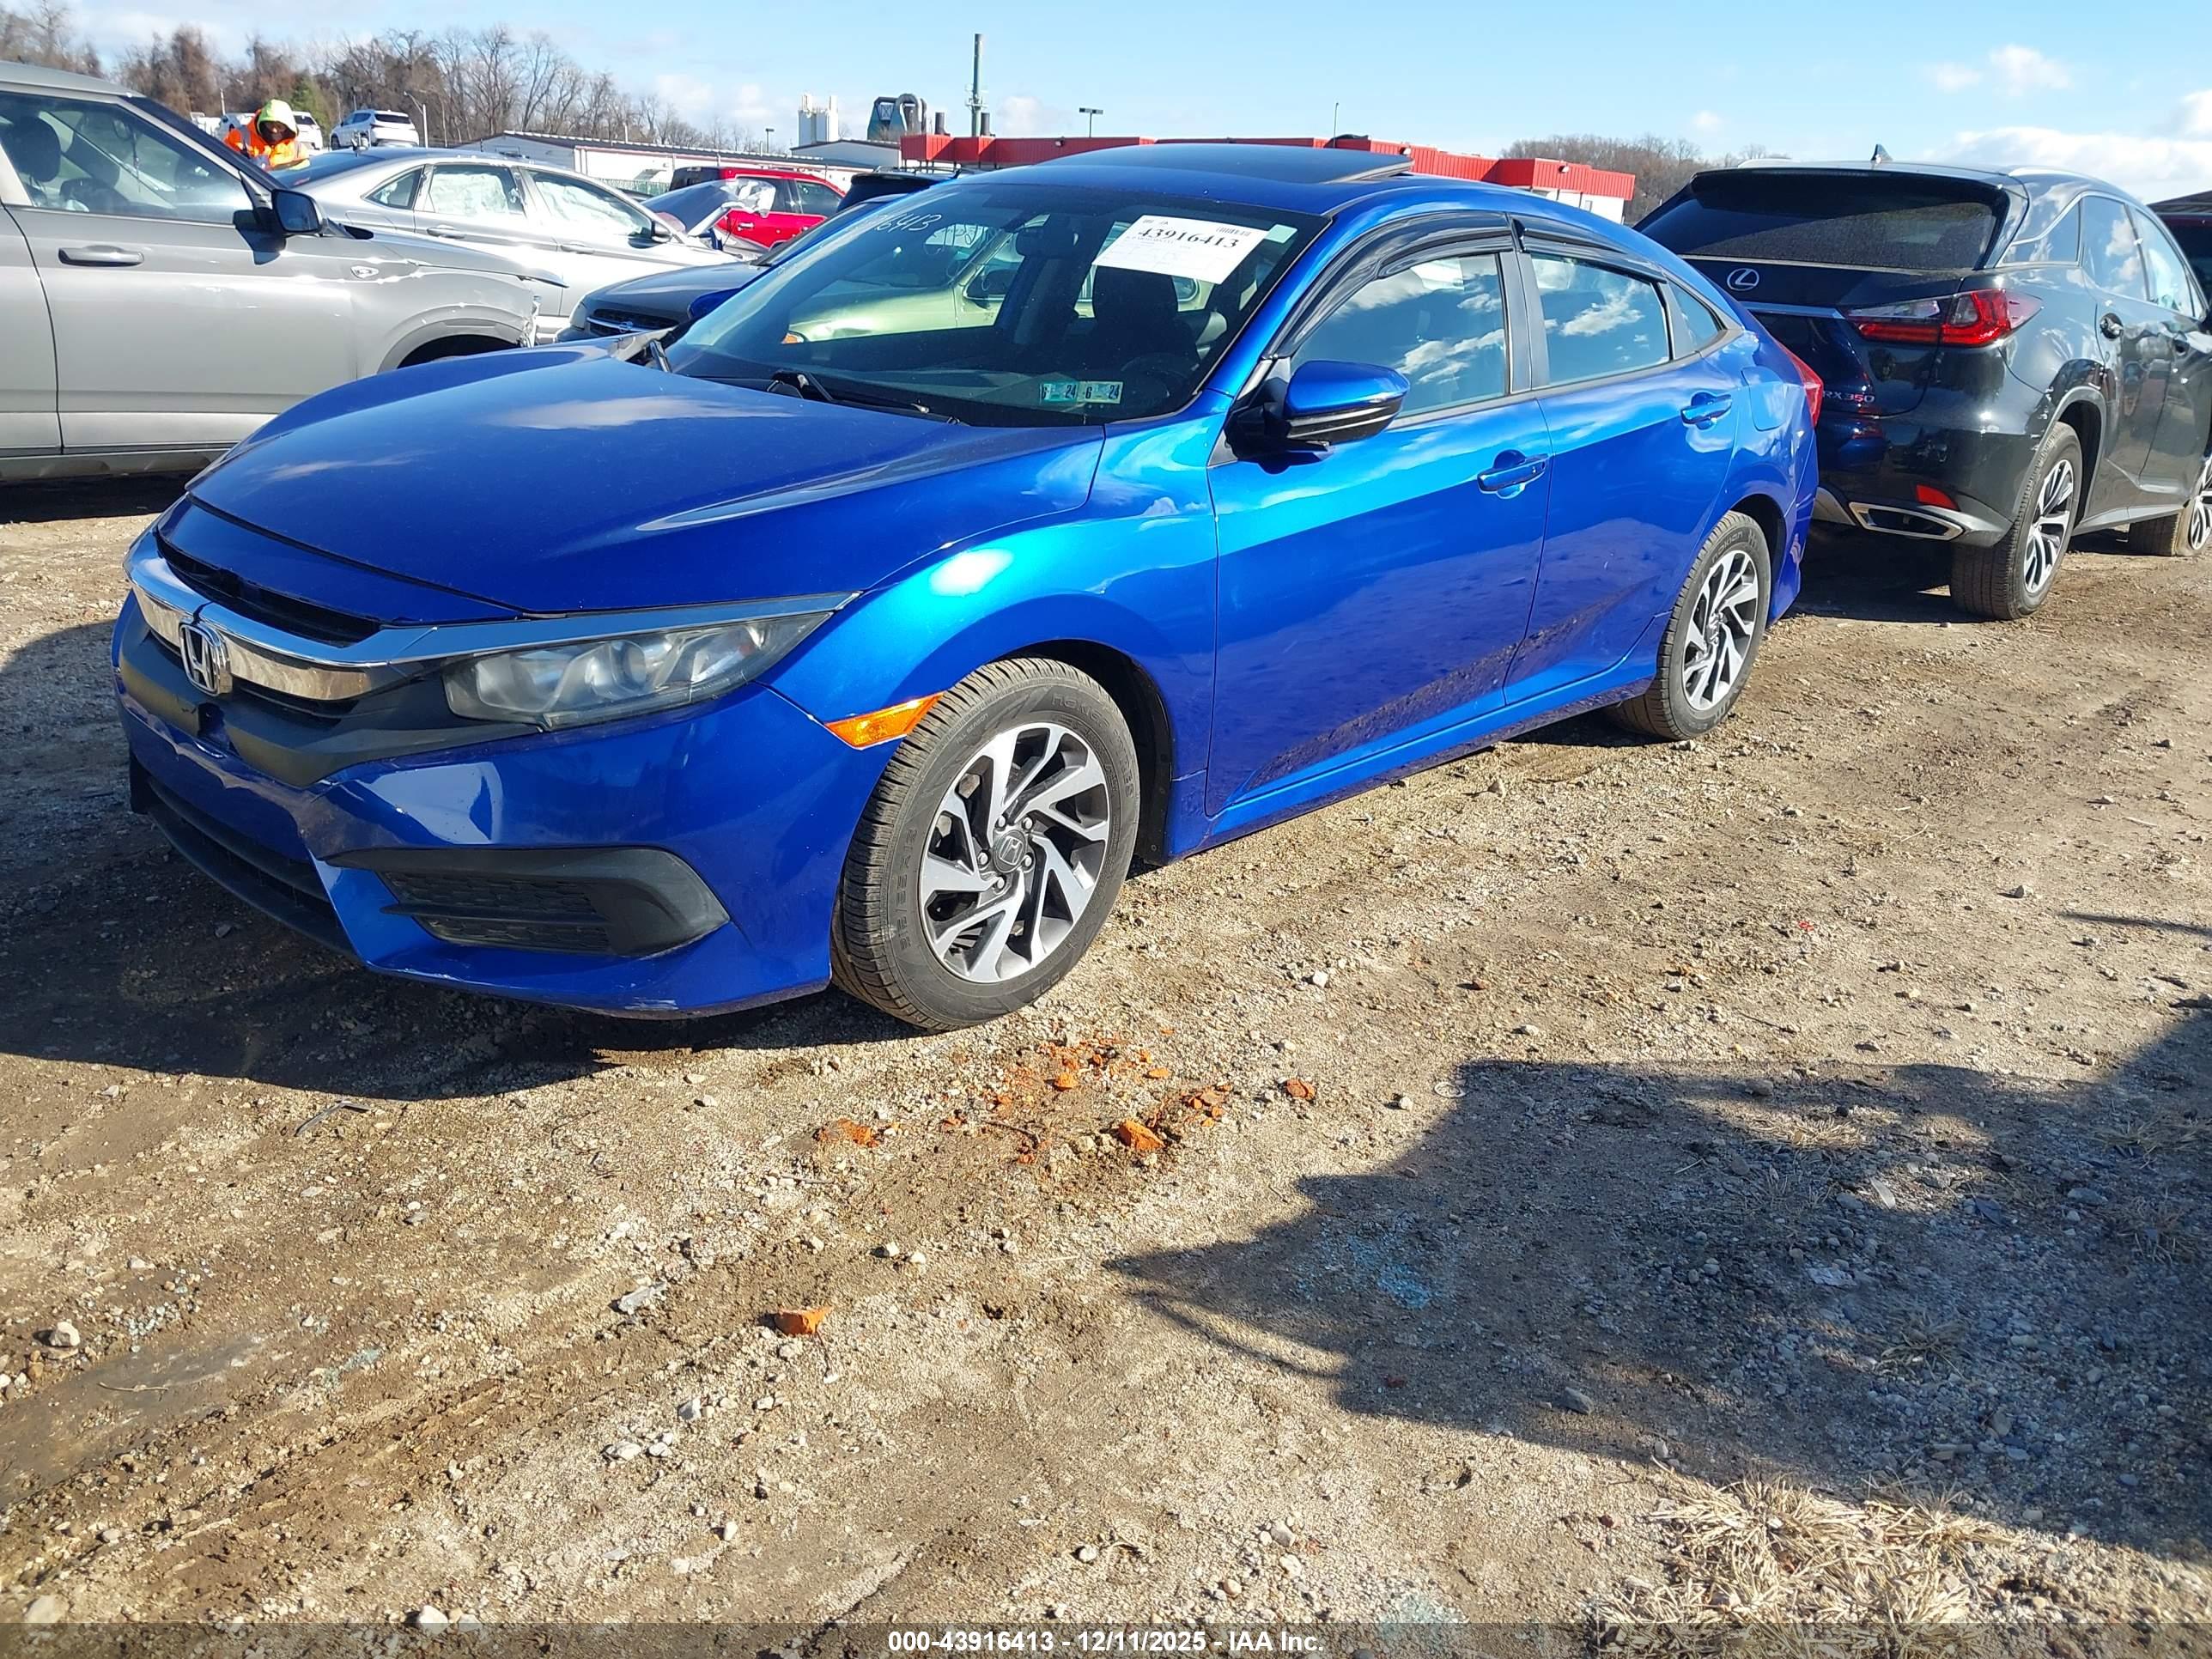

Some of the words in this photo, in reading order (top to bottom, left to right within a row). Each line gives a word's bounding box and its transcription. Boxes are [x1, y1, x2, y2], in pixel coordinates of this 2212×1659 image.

[1138, 227, 1239, 249] 43916413
[1065, 384, 1077, 399] 24
[1085, 386, 1093, 399] 6
[1108, 384, 1120, 399] 24
[1822, 390, 1842, 400] RX
[1844, 392, 1875, 403] 350
